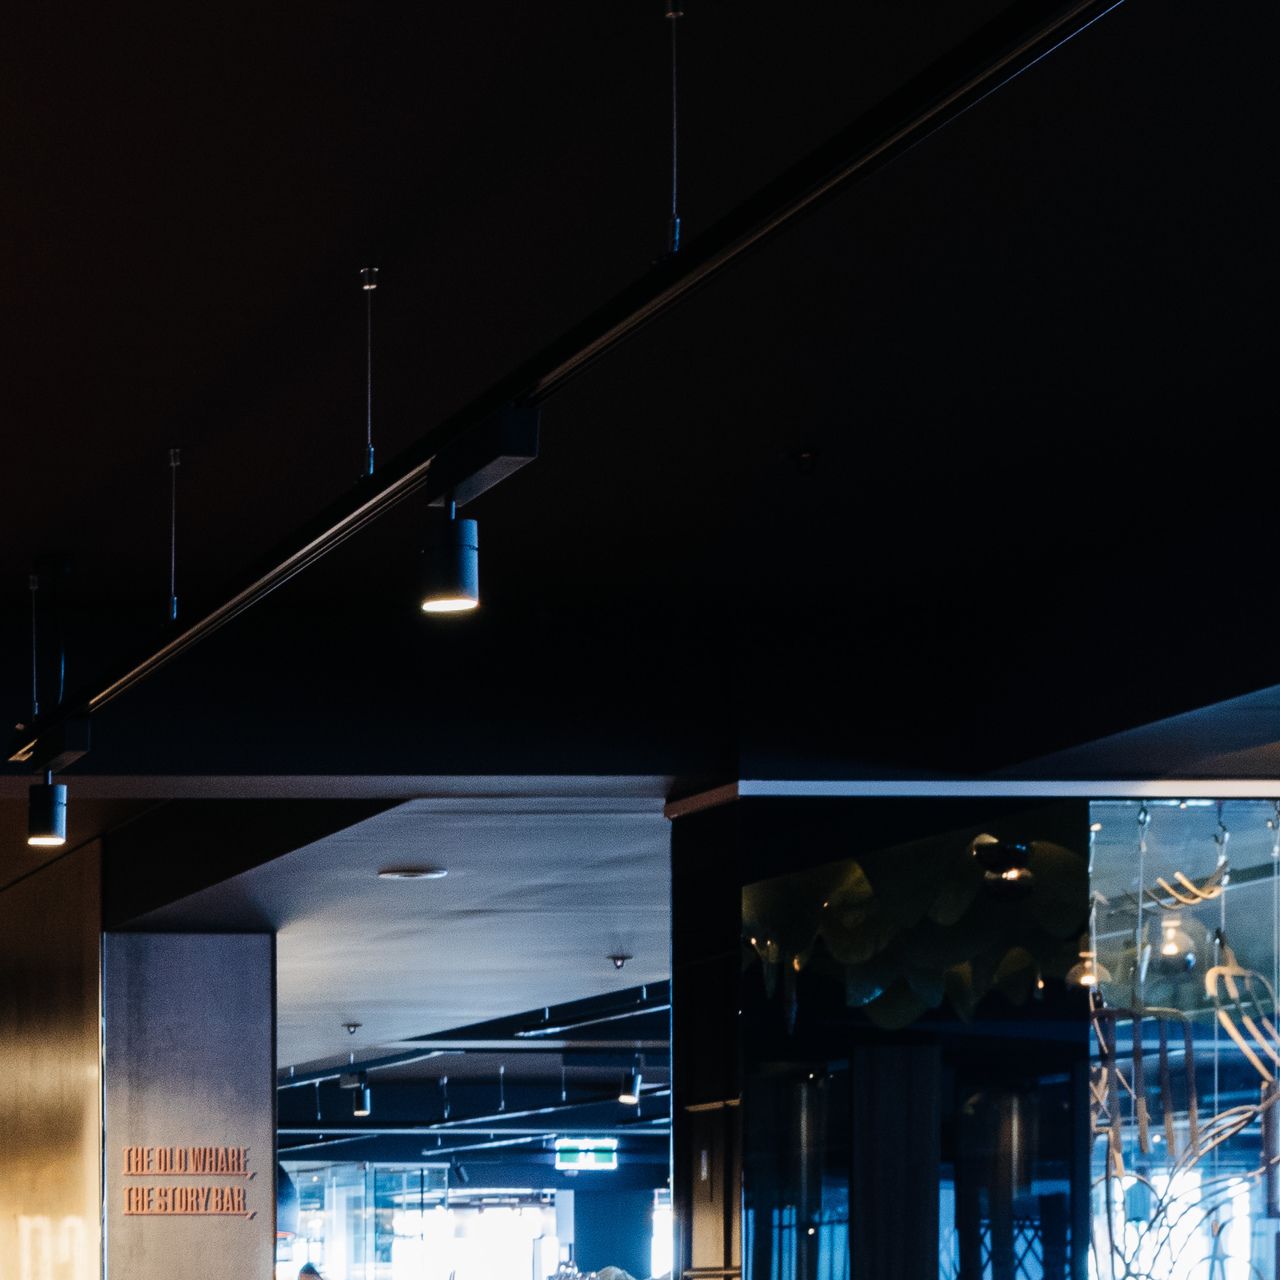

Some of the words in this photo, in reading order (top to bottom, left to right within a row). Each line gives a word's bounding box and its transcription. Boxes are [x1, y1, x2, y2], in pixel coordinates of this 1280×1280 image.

[122, 1146, 154, 1174] THE
[155, 1146, 188, 1174] OLD
[189, 1146, 249, 1174] WHARF
[122, 1186, 154, 1213] THE
[156, 1186, 210, 1213] STORY
[211, 1186, 246, 1213] BAR
